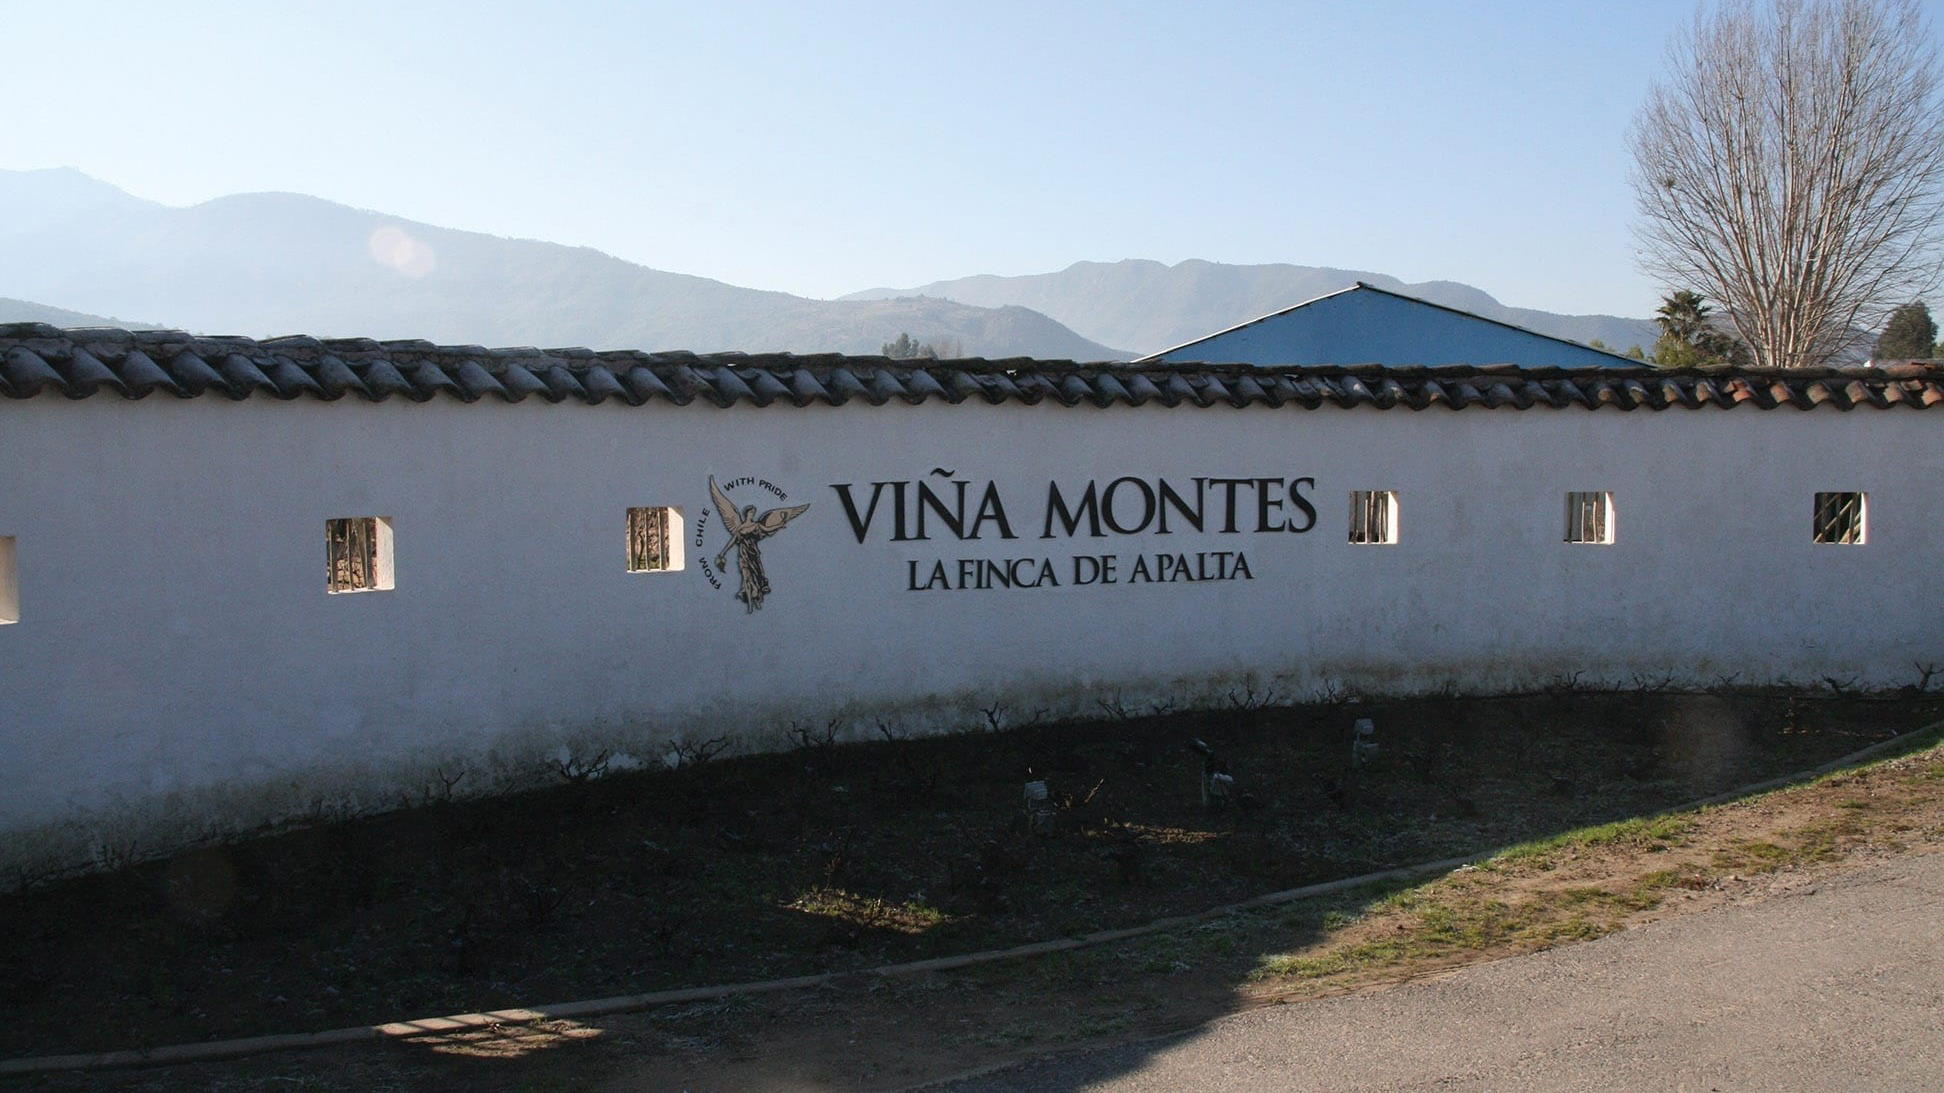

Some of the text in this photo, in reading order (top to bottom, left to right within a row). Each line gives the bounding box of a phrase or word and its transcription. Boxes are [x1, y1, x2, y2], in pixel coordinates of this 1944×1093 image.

[695, 476, 788, 590] FROM CHILE WITH PRIDE
[829, 467, 1317, 544] VIÑA MONTES
[907, 551, 1255, 591] LA FINCA DE APALTA
